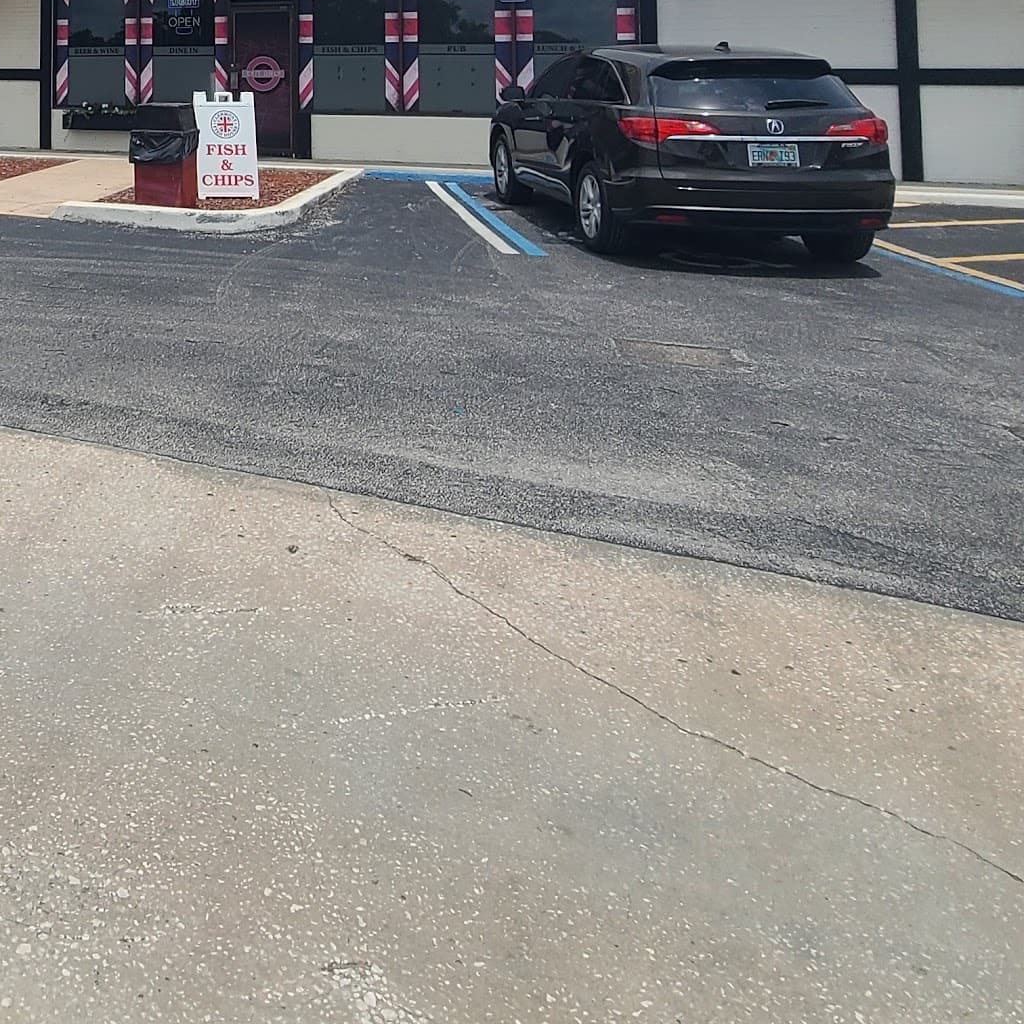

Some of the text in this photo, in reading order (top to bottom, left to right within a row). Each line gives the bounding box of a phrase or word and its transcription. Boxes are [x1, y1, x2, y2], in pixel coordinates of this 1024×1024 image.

[168, 15, 201, 28] OPEN
[99, 47, 120, 55] WINE
[321, 46, 342, 54] FISH
[351, 46, 378, 54] CHIPS
[447, 45, 467, 53] PUB
[206, 144, 248, 156] FISH
[221, 159, 234, 171] &
[202, 174, 255, 187] CHIPS
